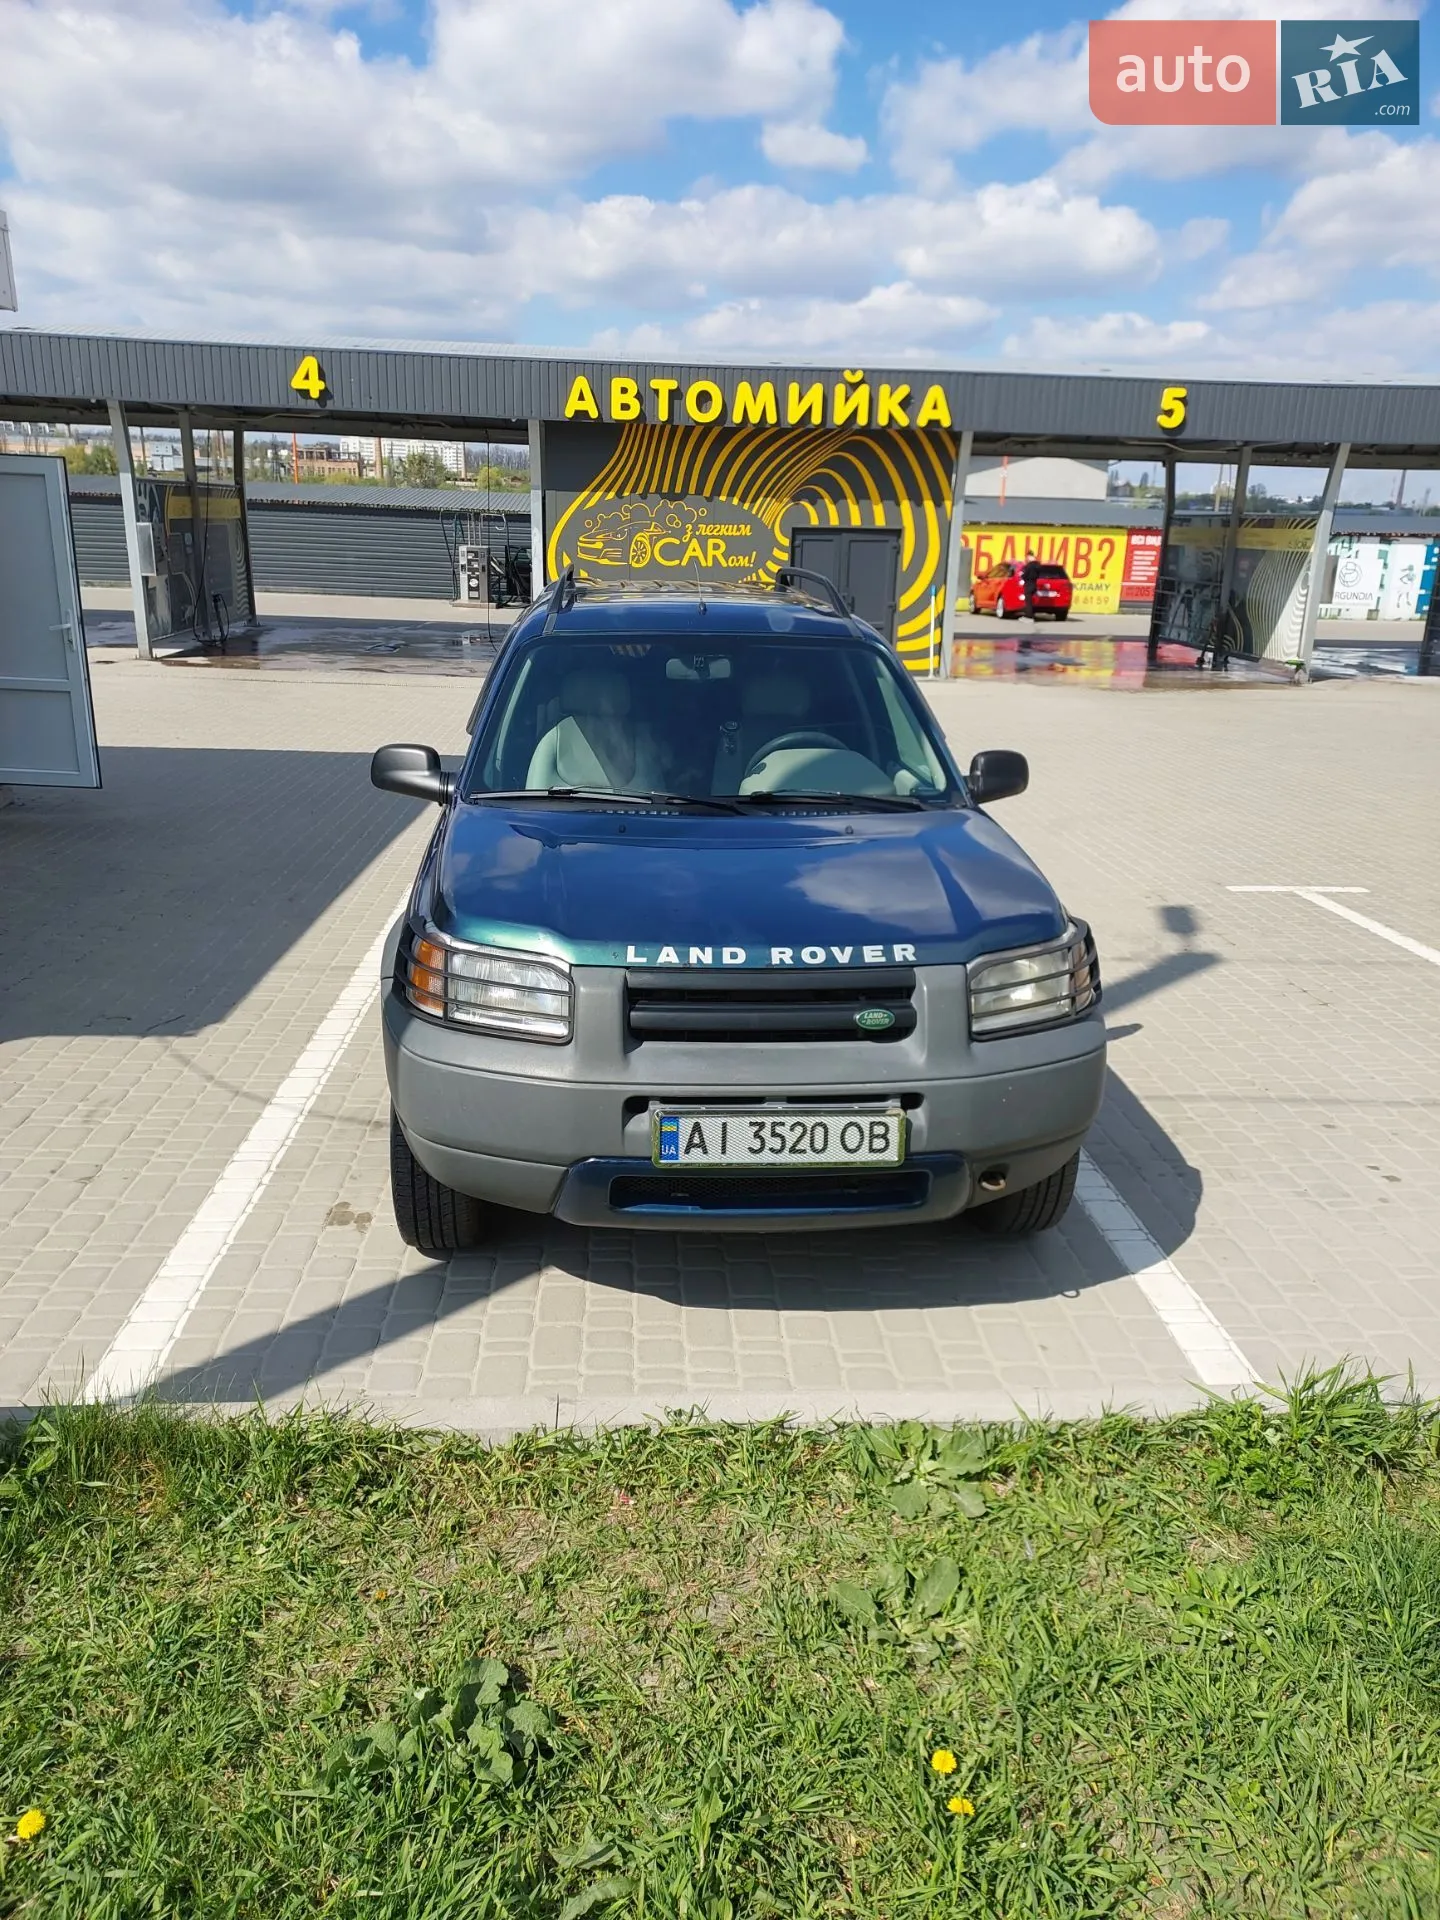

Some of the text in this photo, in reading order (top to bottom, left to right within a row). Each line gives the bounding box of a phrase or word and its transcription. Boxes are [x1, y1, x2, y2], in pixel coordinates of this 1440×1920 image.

[291, 355, 325, 400] 4
[564, 369, 952, 428] АВТОМИЙКА
[1157, 387, 1188, 430] 5
[696, 524, 752, 536] легким
[626, 943, 917, 965] LAND ROVER
[661, 1145, 677, 1156] UA
[684, 1121, 890, 1155] AI 3520 OB
